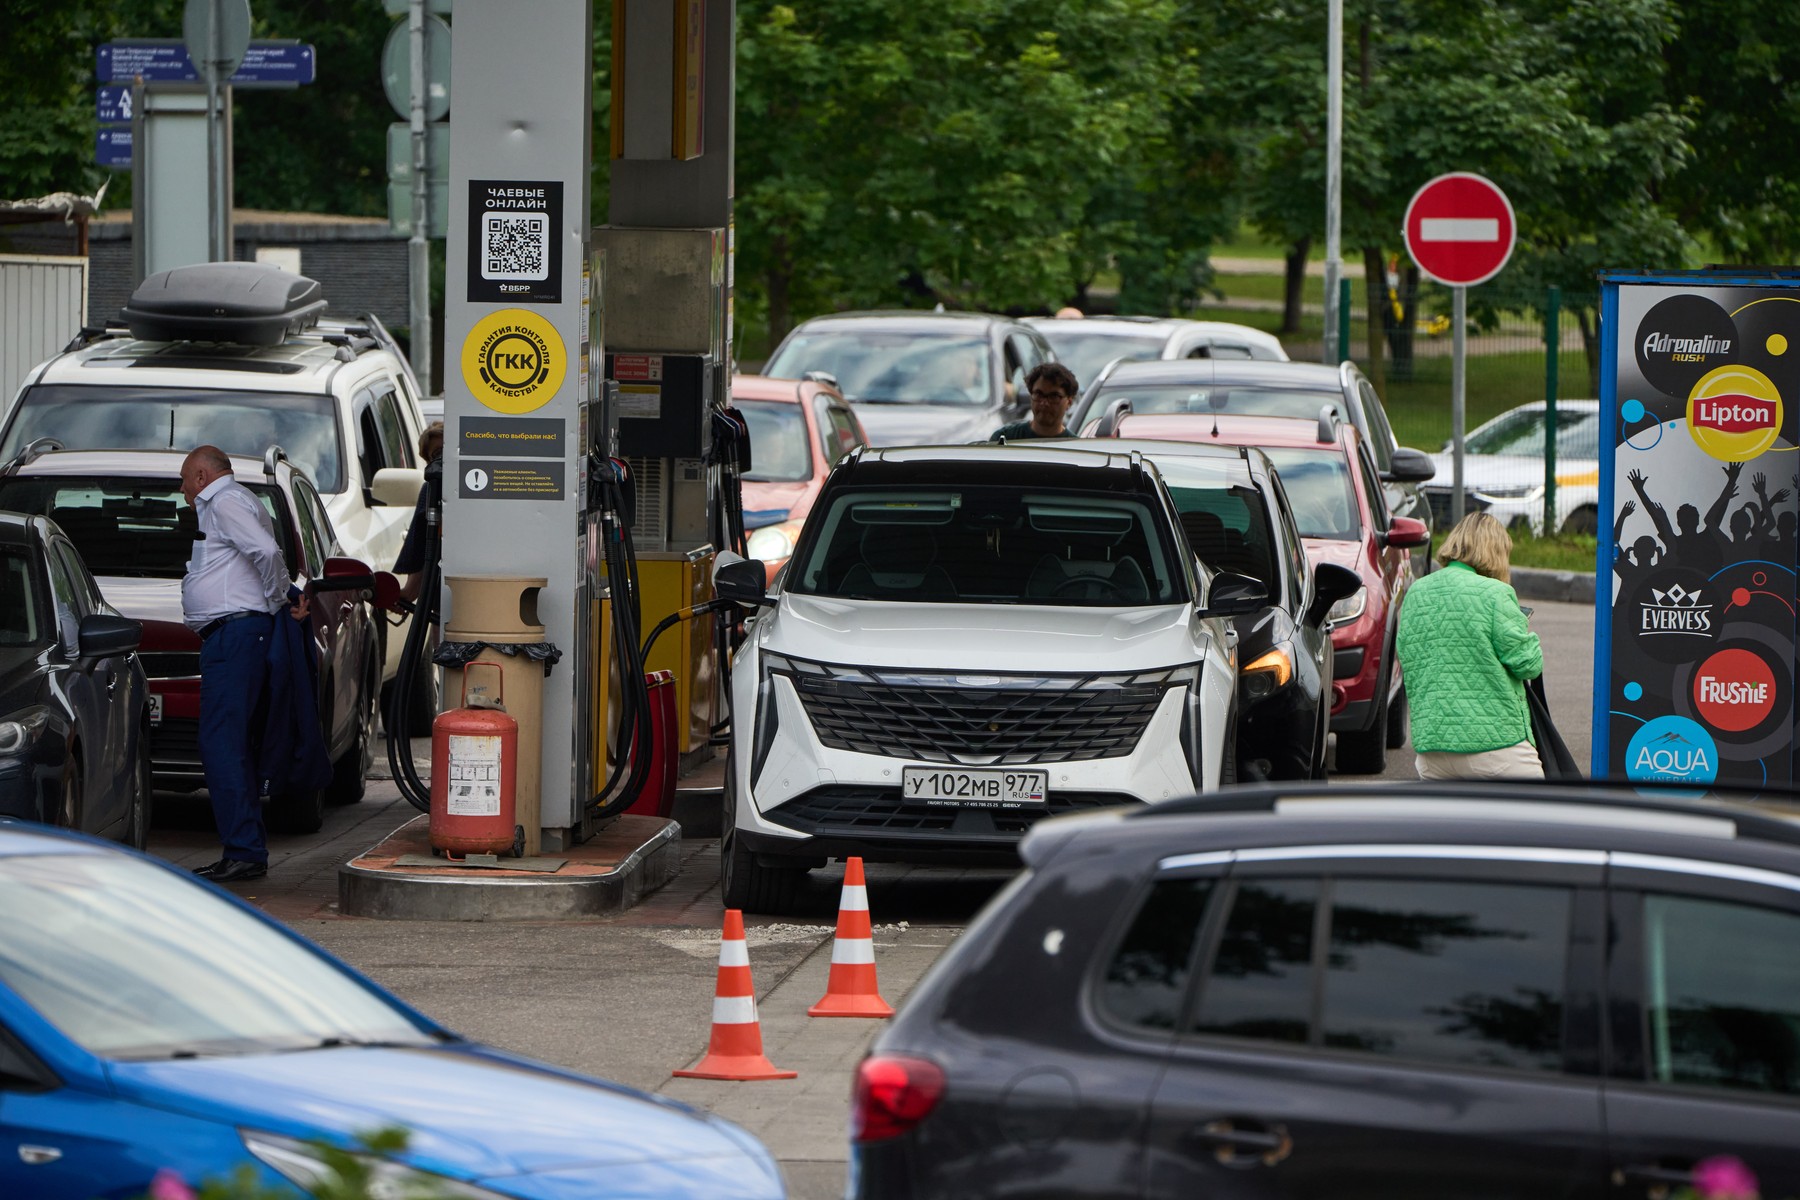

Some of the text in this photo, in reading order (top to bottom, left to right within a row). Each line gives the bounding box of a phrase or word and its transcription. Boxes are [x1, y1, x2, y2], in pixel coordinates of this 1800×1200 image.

[488, 189, 544, 198] ЧАЕВЫЕ
[486, 198, 546, 209] ОНЛАЙН
[479, 326, 550, 364] ГАРАНТИЯ КОНТРОЛЯ
[1643, 332, 1731, 361] Adrenaline
[495, 354, 534, 370] ГКК
[1672, 354, 1705, 362] RUSH
[490, 383, 538, 397] КАЧЕСТВА
[1700, 402, 1769, 426] Lipton
[466, 432, 496, 440] Спасибо,
[511, 432, 541, 441] выбрали
[1642, 609, 1711, 631] EVERVESS
[1635, 747, 1709, 775] AQUA
[1006, 775, 1039, 792] 977
